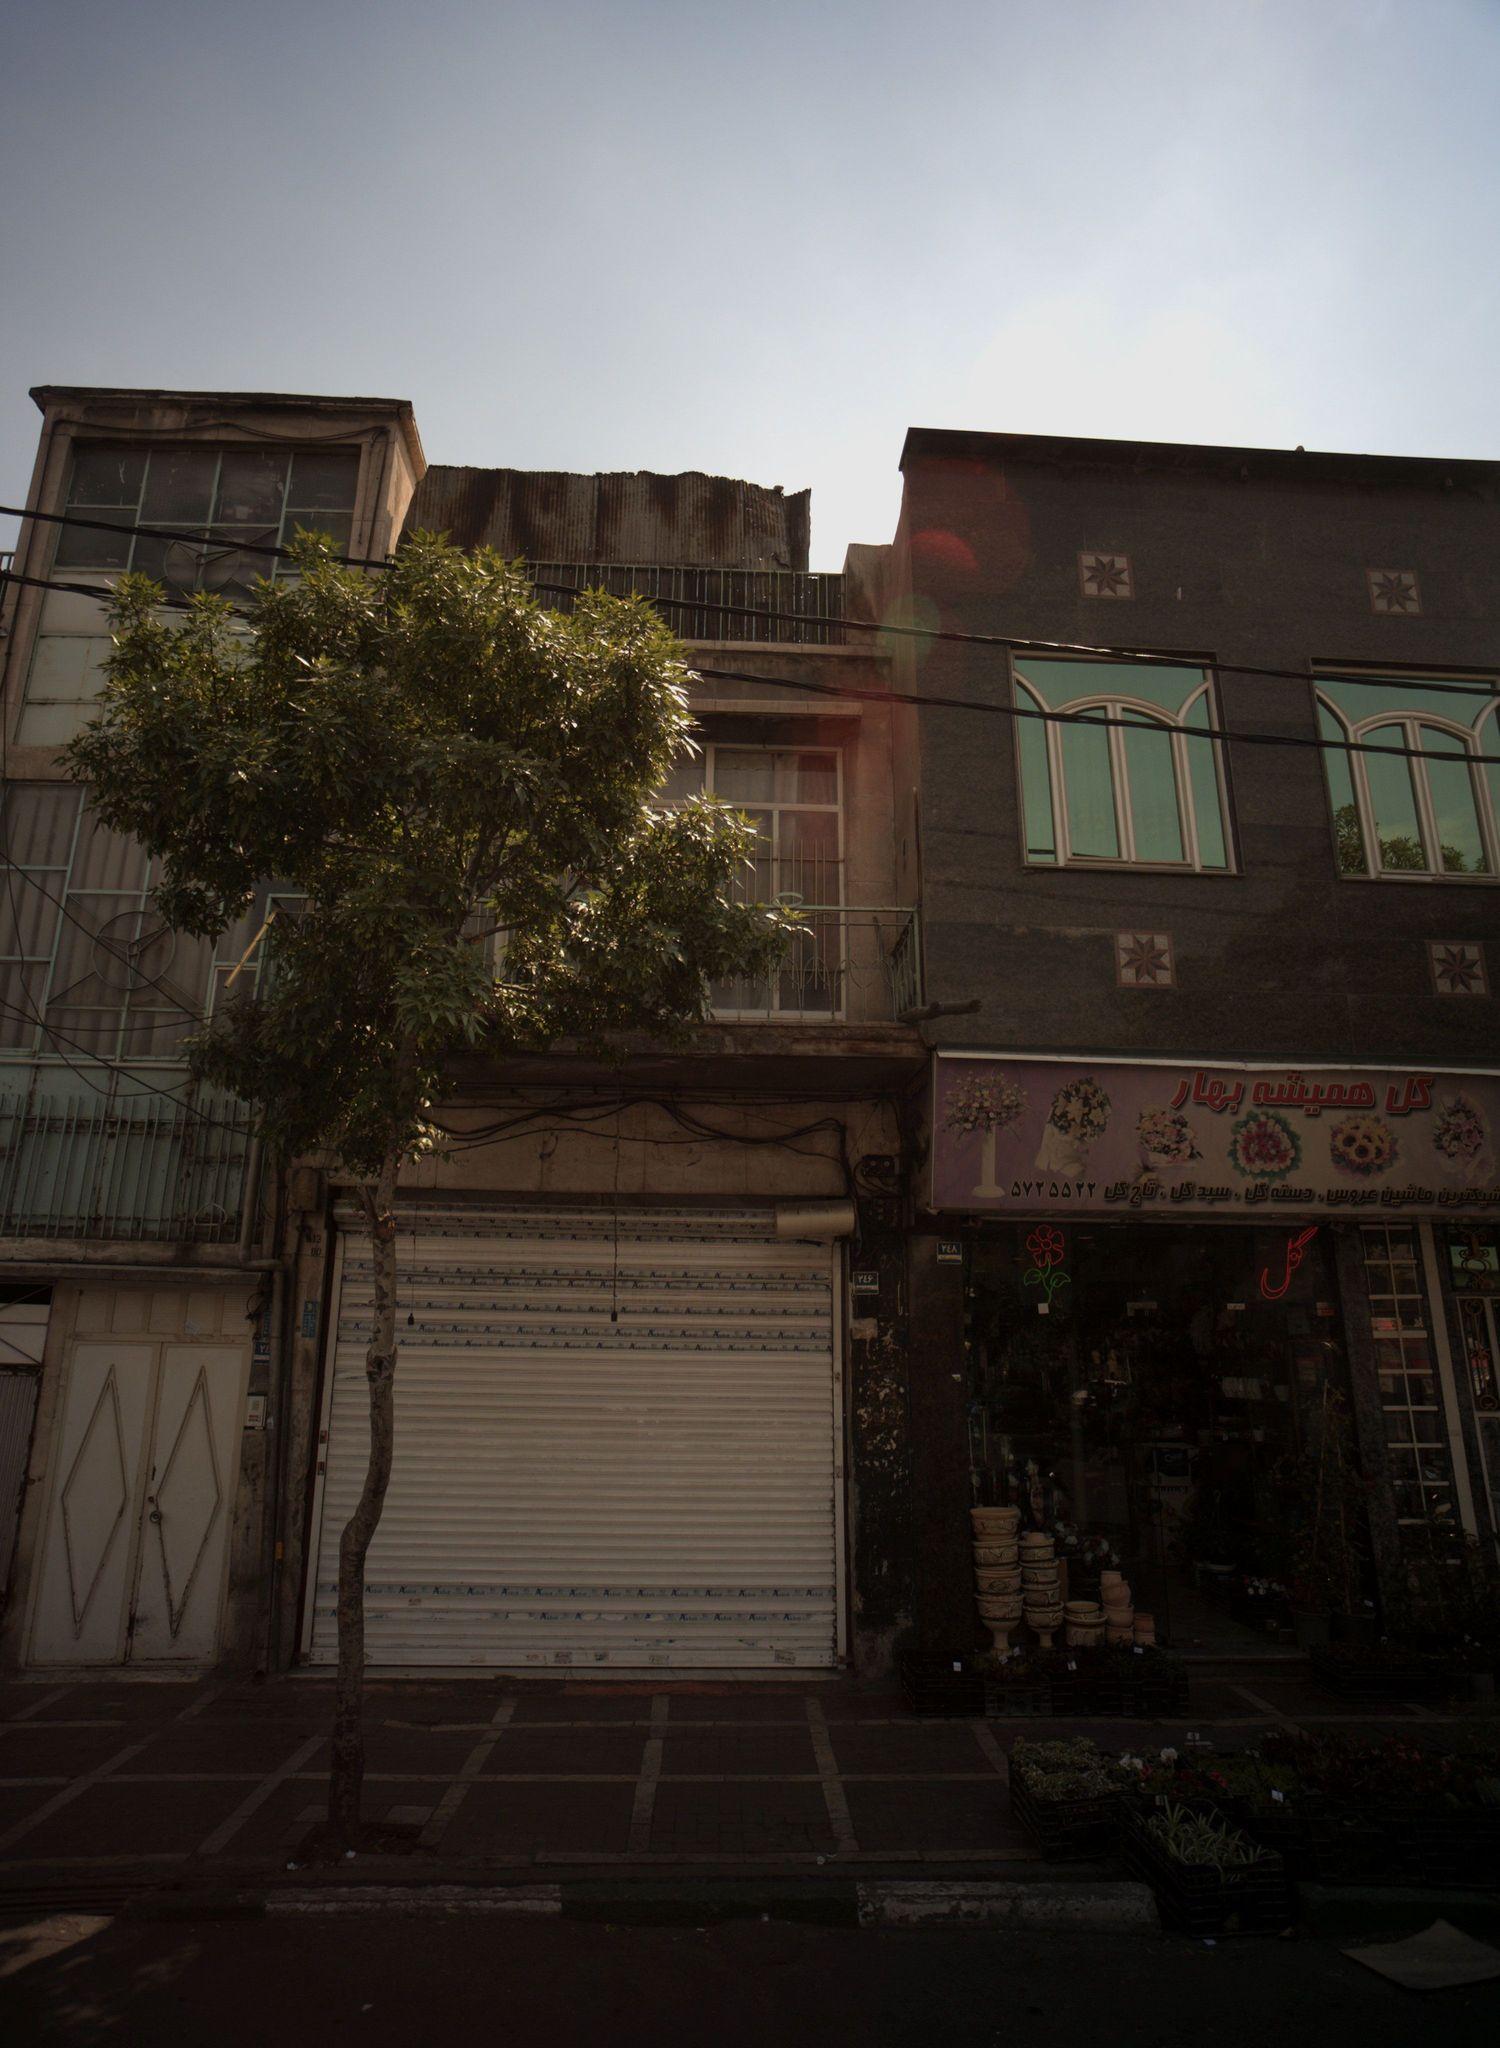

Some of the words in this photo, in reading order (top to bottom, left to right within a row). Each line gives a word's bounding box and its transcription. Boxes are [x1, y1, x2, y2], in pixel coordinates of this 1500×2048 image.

[1169, 1071, 1244, 1112] بهار
[1252, 1070, 1375, 1116] همیشه
[1384, 1074, 1434, 1114] گل
[1104, 1182, 1129, 1200] گل
[1130, 1182, 1157, 1205] تاج
[1170, 1182, 1194, 1200] گل
[1197, 1186, 1230, 1201] سبد
[1244, 1182, 1269, 1201] گل
[1270, 1185, 1313, 1200] دسته
[1327, 1188, 1377, 1203] عروس
[1380, 1184, 1433, 1205] ماشین
